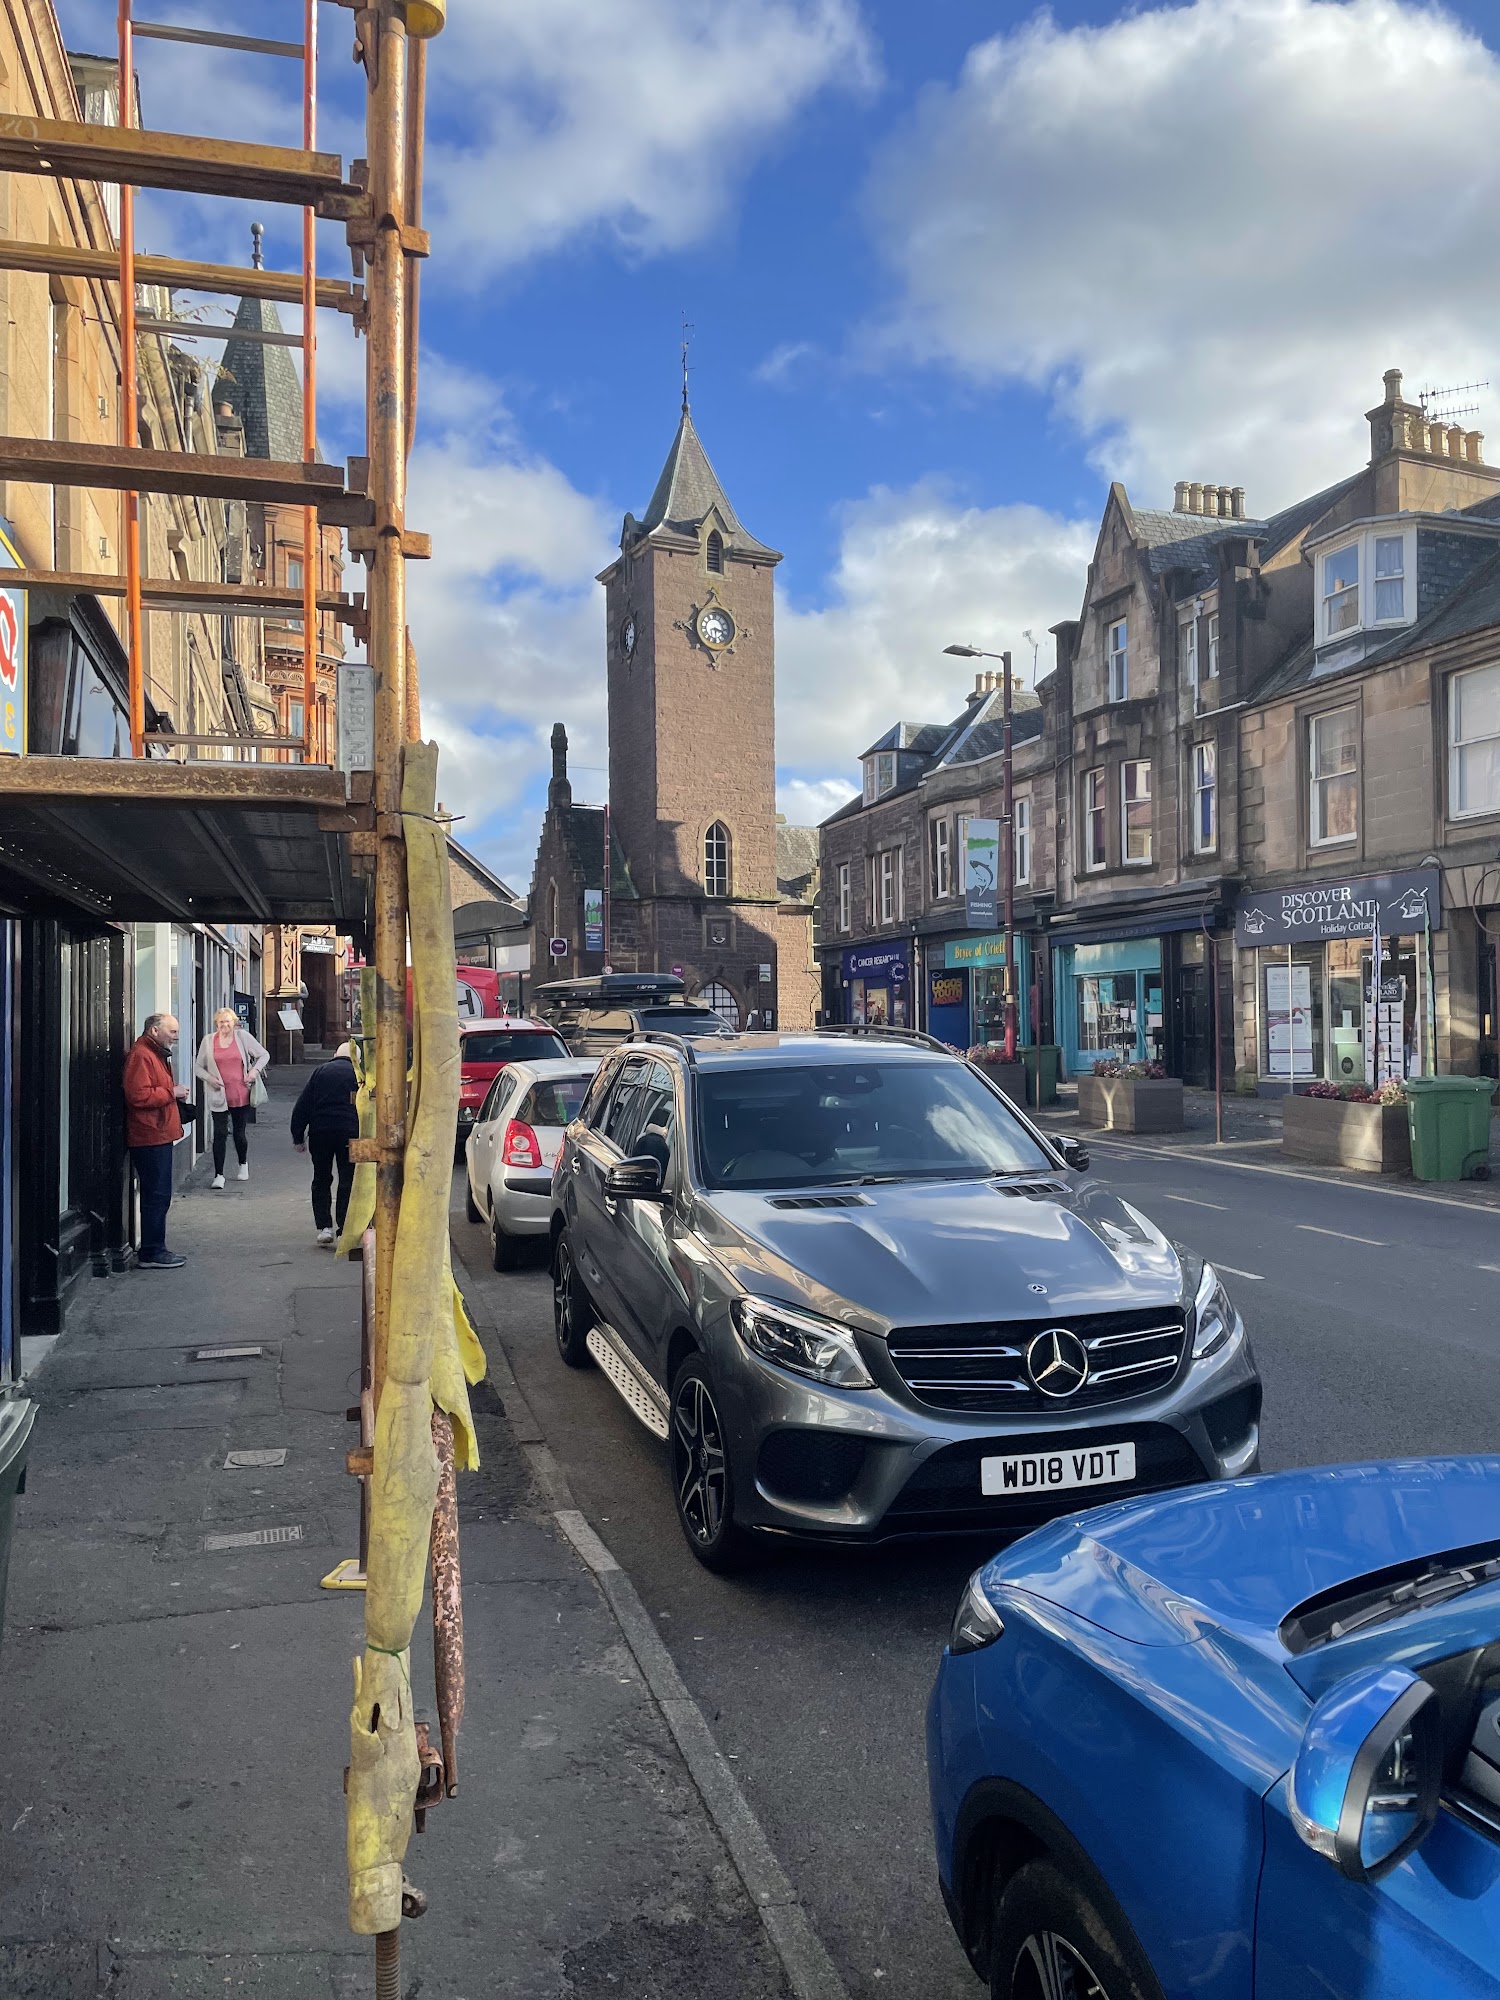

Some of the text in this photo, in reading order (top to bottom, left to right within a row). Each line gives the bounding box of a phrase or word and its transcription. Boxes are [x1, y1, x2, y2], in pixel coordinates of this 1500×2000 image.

[348, 670, 366, 768] EN 12811-1
[1281, 887, 1352, 908] DISCOVER
[1281, 900, 1380, 929] SCOTLAND
[1320, 924, 1347, 935] Holiday
[954, 945, 973, 960] Bryce
[974, 943, 983, 956] of
[858, 957, 874, 967] CANCER
[874, 955, 893, 965] RESEARCH
[931, 978, 962, 990] LOGOS
[932, 987, 962, 998] YOUTH
[238, 1005, 247, 1014] P
[1003, 1450, 1120, 1488] WD18 VDT
